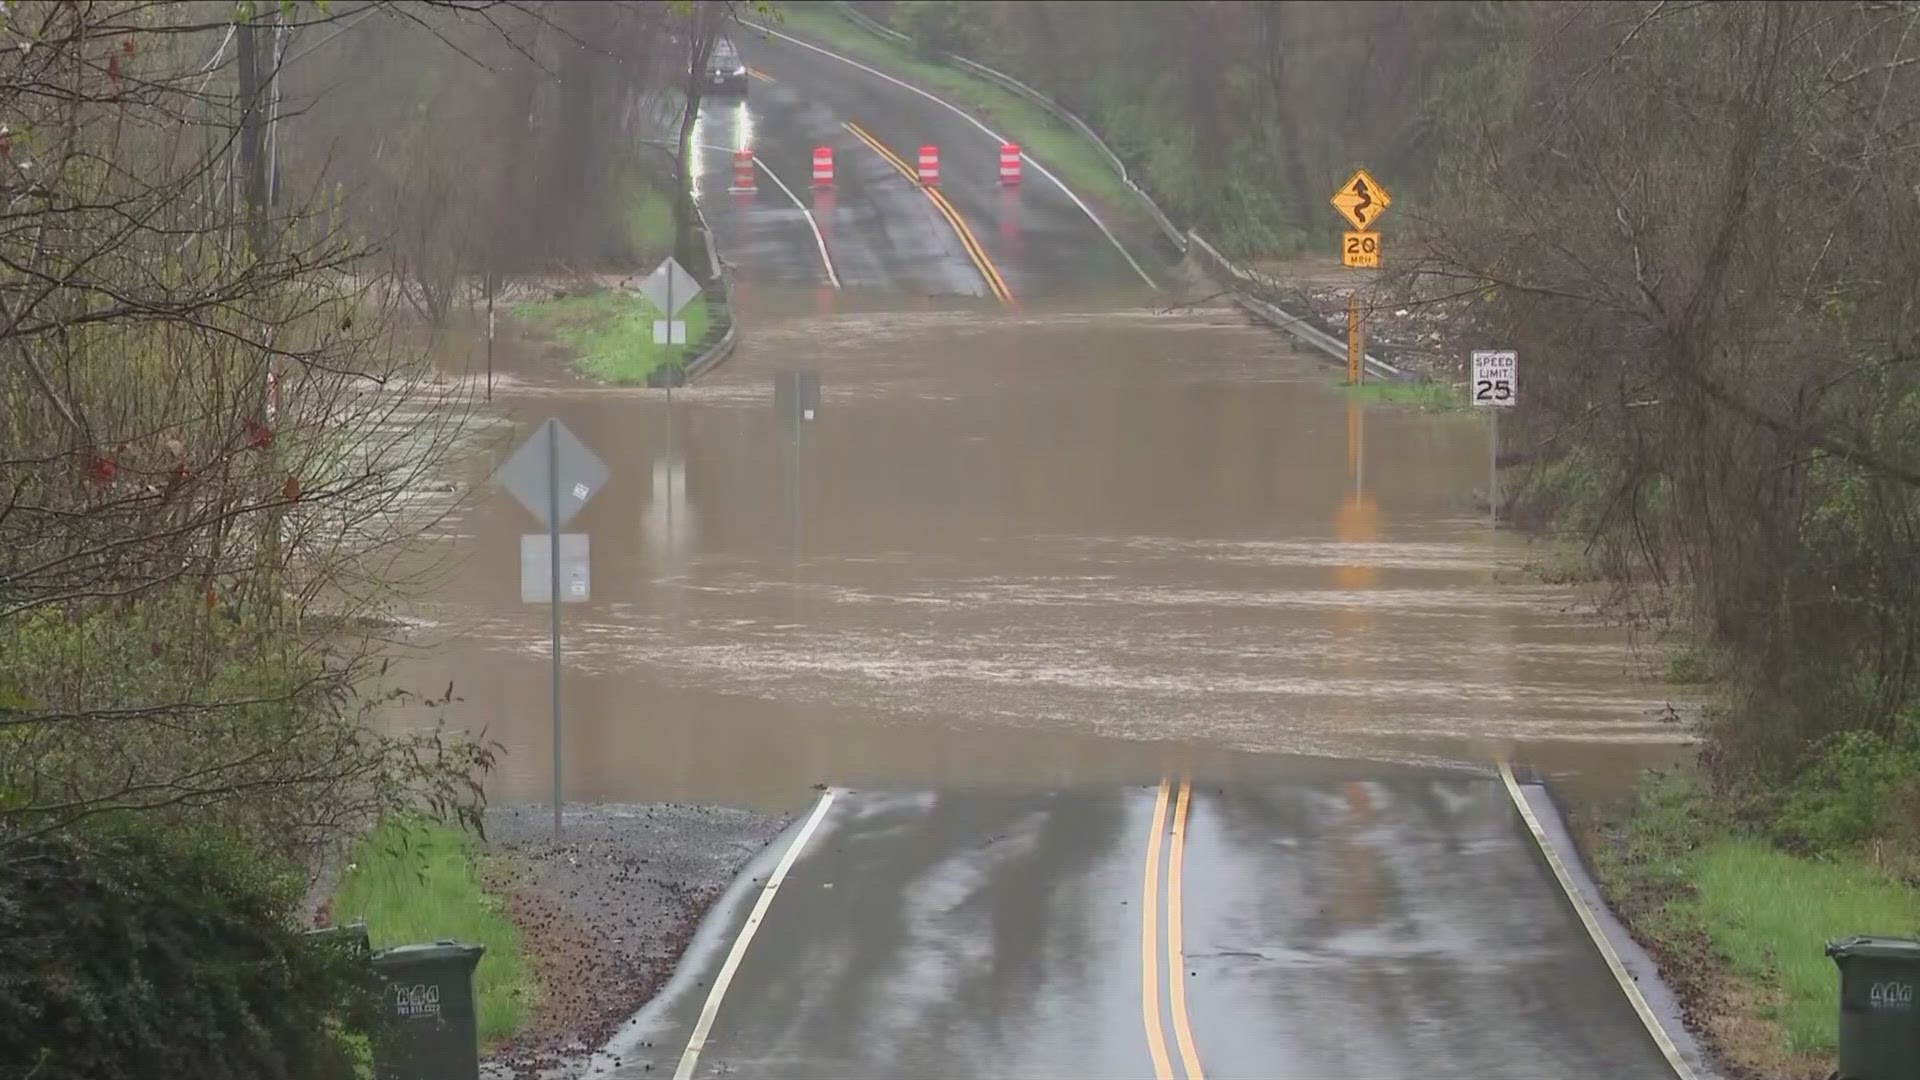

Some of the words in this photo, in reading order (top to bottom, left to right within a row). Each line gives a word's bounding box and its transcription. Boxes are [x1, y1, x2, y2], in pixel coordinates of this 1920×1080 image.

[1347, 237, 1376, 254] 20
[1350, 255, 1372, 264] MPH
[1475, 357, 1513, 367] SPEED
[1479, 369, 1508, 379] LIMIT
[1476, 380, 1511, 400] 25
